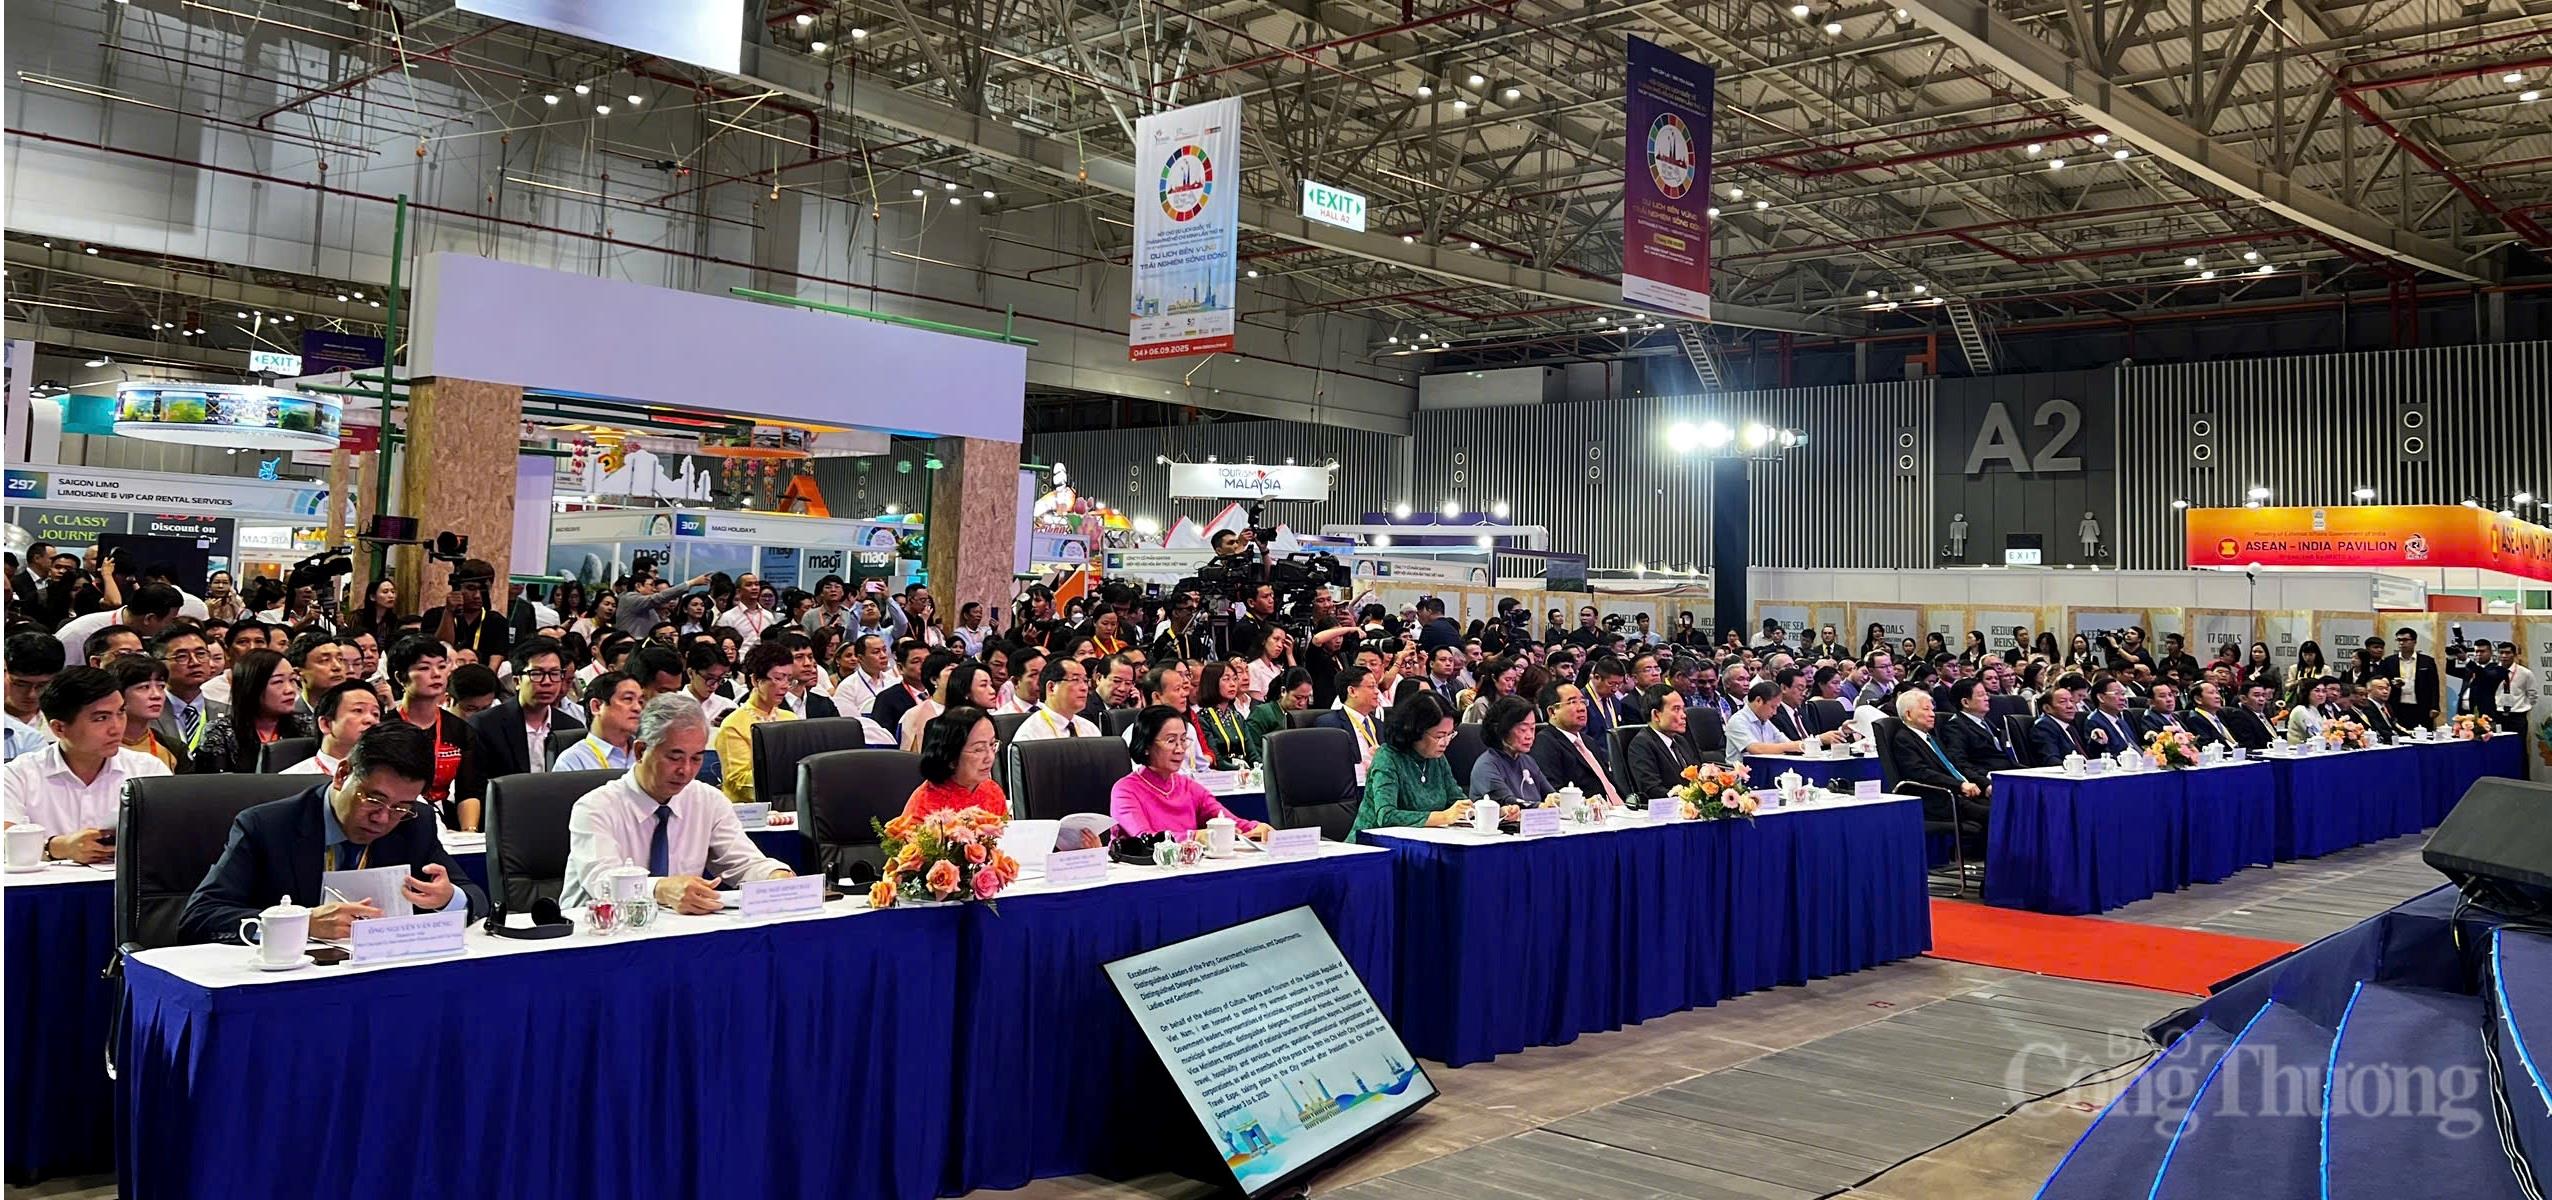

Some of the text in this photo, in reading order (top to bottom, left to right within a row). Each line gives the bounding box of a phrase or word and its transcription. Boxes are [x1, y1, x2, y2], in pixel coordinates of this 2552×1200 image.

[1316, 188, 1354, 214] EXIT
[1320, 209, 1350, 224] HALL A2
[262, 354, 294, 368] EXIT
[1964, 399, 2082, 474] A2
[8, 479, 37, 490] 297
[58, 478, 94, 488] SAIGON
[1224, 478, 1281, 494] MALAYSIA
[58, 490, 108, 498] LIMOUSINE
[118, 492, 134, 500] VIP
[155, 495, 190, 504] RENTAL
[192, 497, 232, 506] SERVICES
[38, 515, 110, 528] A CLASSY
[151, 522, 200, 532] Discount
[681, 521, 700, 530] 307
[38, 530, 98, 541] JOURNE
[2246, 542, 2286, 550] ASEAN
[2299, 542, 2332, 550] INDIA
[2338, 542, 2396, 550] PAVILION
[860, 551, 889, 568] magi
[2008, 552, 2037, 560] EXIT
[808, 552, 841, 573] magi
[1792, 621, 1804, 630] SEA
[2218, 633, 2242, 644] GOALS
[2335, 634, 2360, 646] REDUCE
